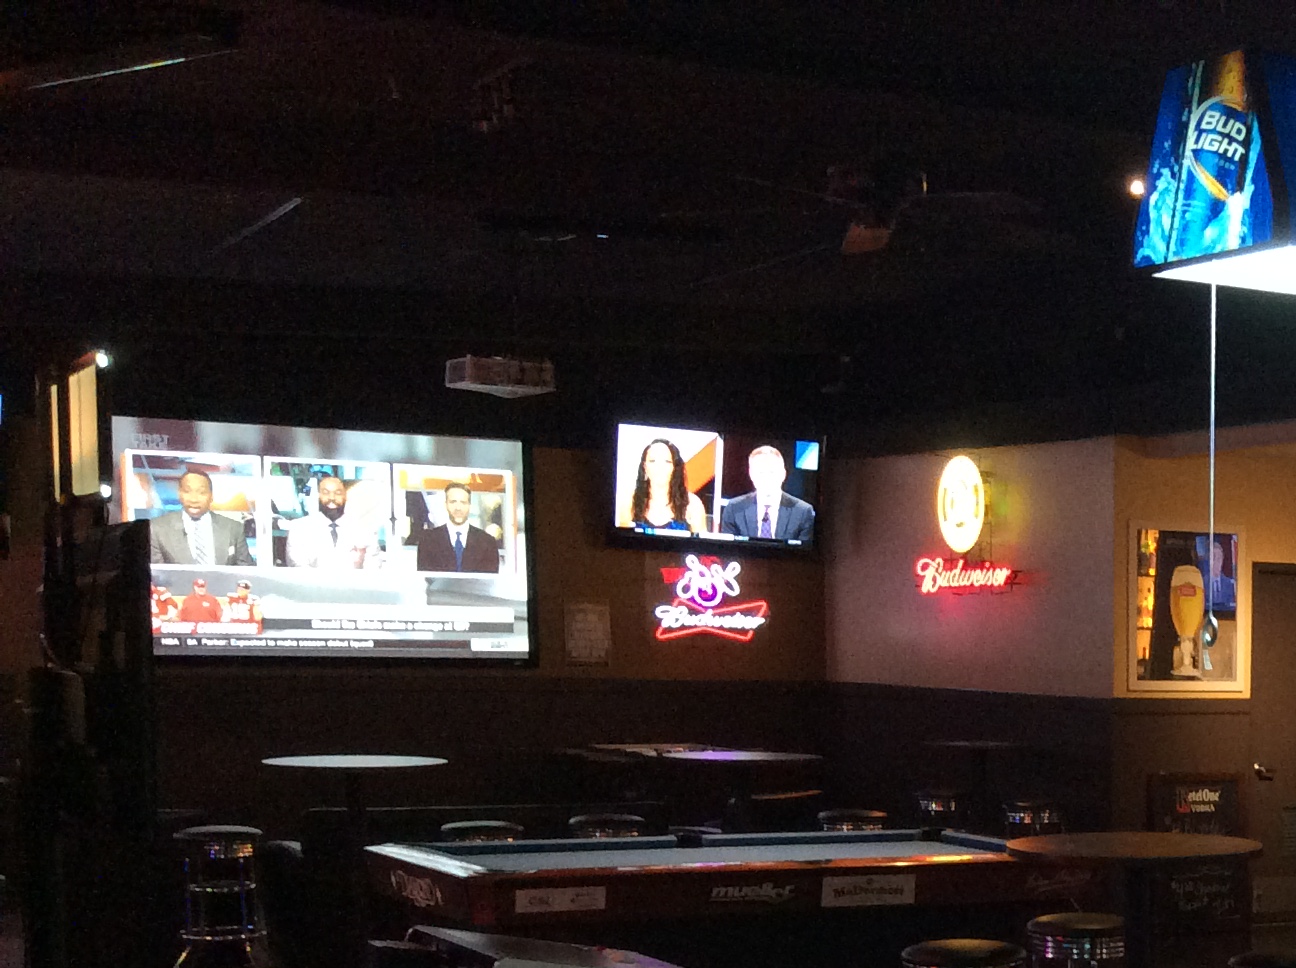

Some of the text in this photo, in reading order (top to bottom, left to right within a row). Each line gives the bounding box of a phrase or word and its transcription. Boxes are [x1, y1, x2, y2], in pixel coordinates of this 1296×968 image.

[1200, 110, 1247, 142] BUD
[1189, 131, 1247, 162] LIGHT
[917, 557, 1011, 593] Budweiser
